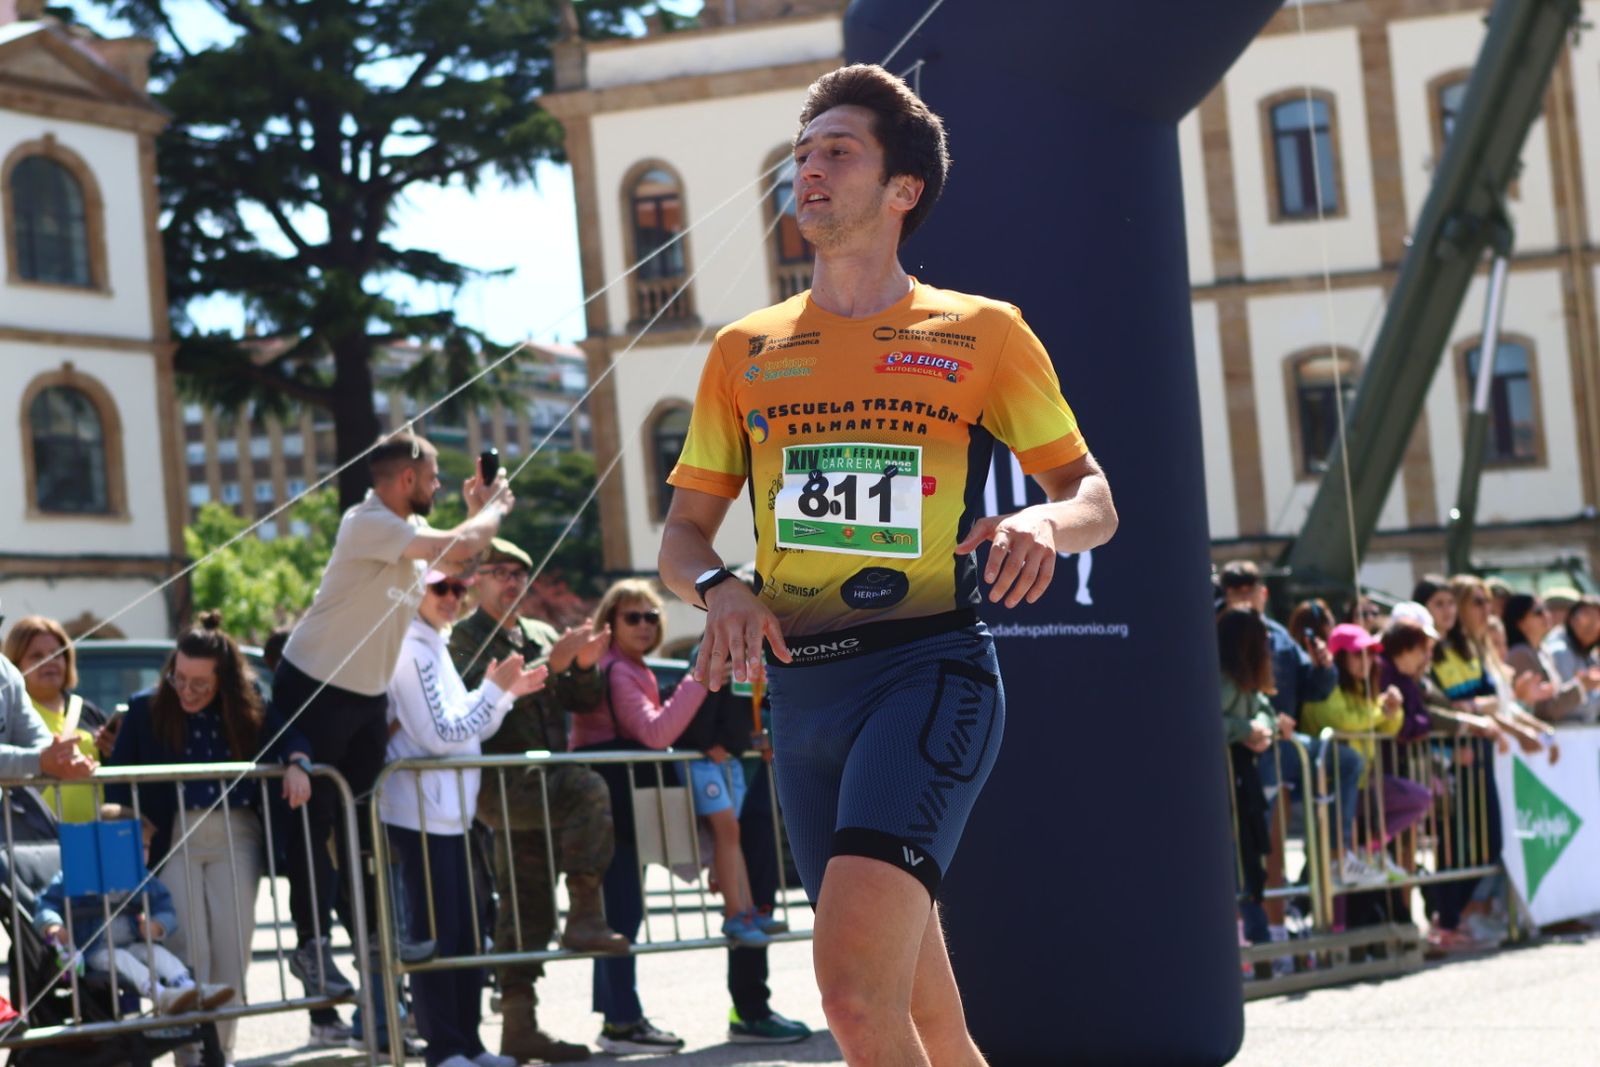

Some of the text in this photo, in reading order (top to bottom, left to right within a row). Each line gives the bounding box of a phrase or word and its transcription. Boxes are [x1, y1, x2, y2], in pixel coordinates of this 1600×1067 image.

[777, 339, 820, 350] Salamanca
[941, 338, 976, 350] DENTAL
[917, 355, 959, 371] ELICES
[886, 366, 944, 377] AUTOESCUELA
[767, 400, 855, 419] ESCUELA
[788, 418, 928, 435] SALMANTINA
[788, 448, 915, 470] XIV SAN FERNANDO
[822, 457, 882, 471] CARRERA
[798, 475, 892, 523] 811
[787, 638, 860, 657] WONG
